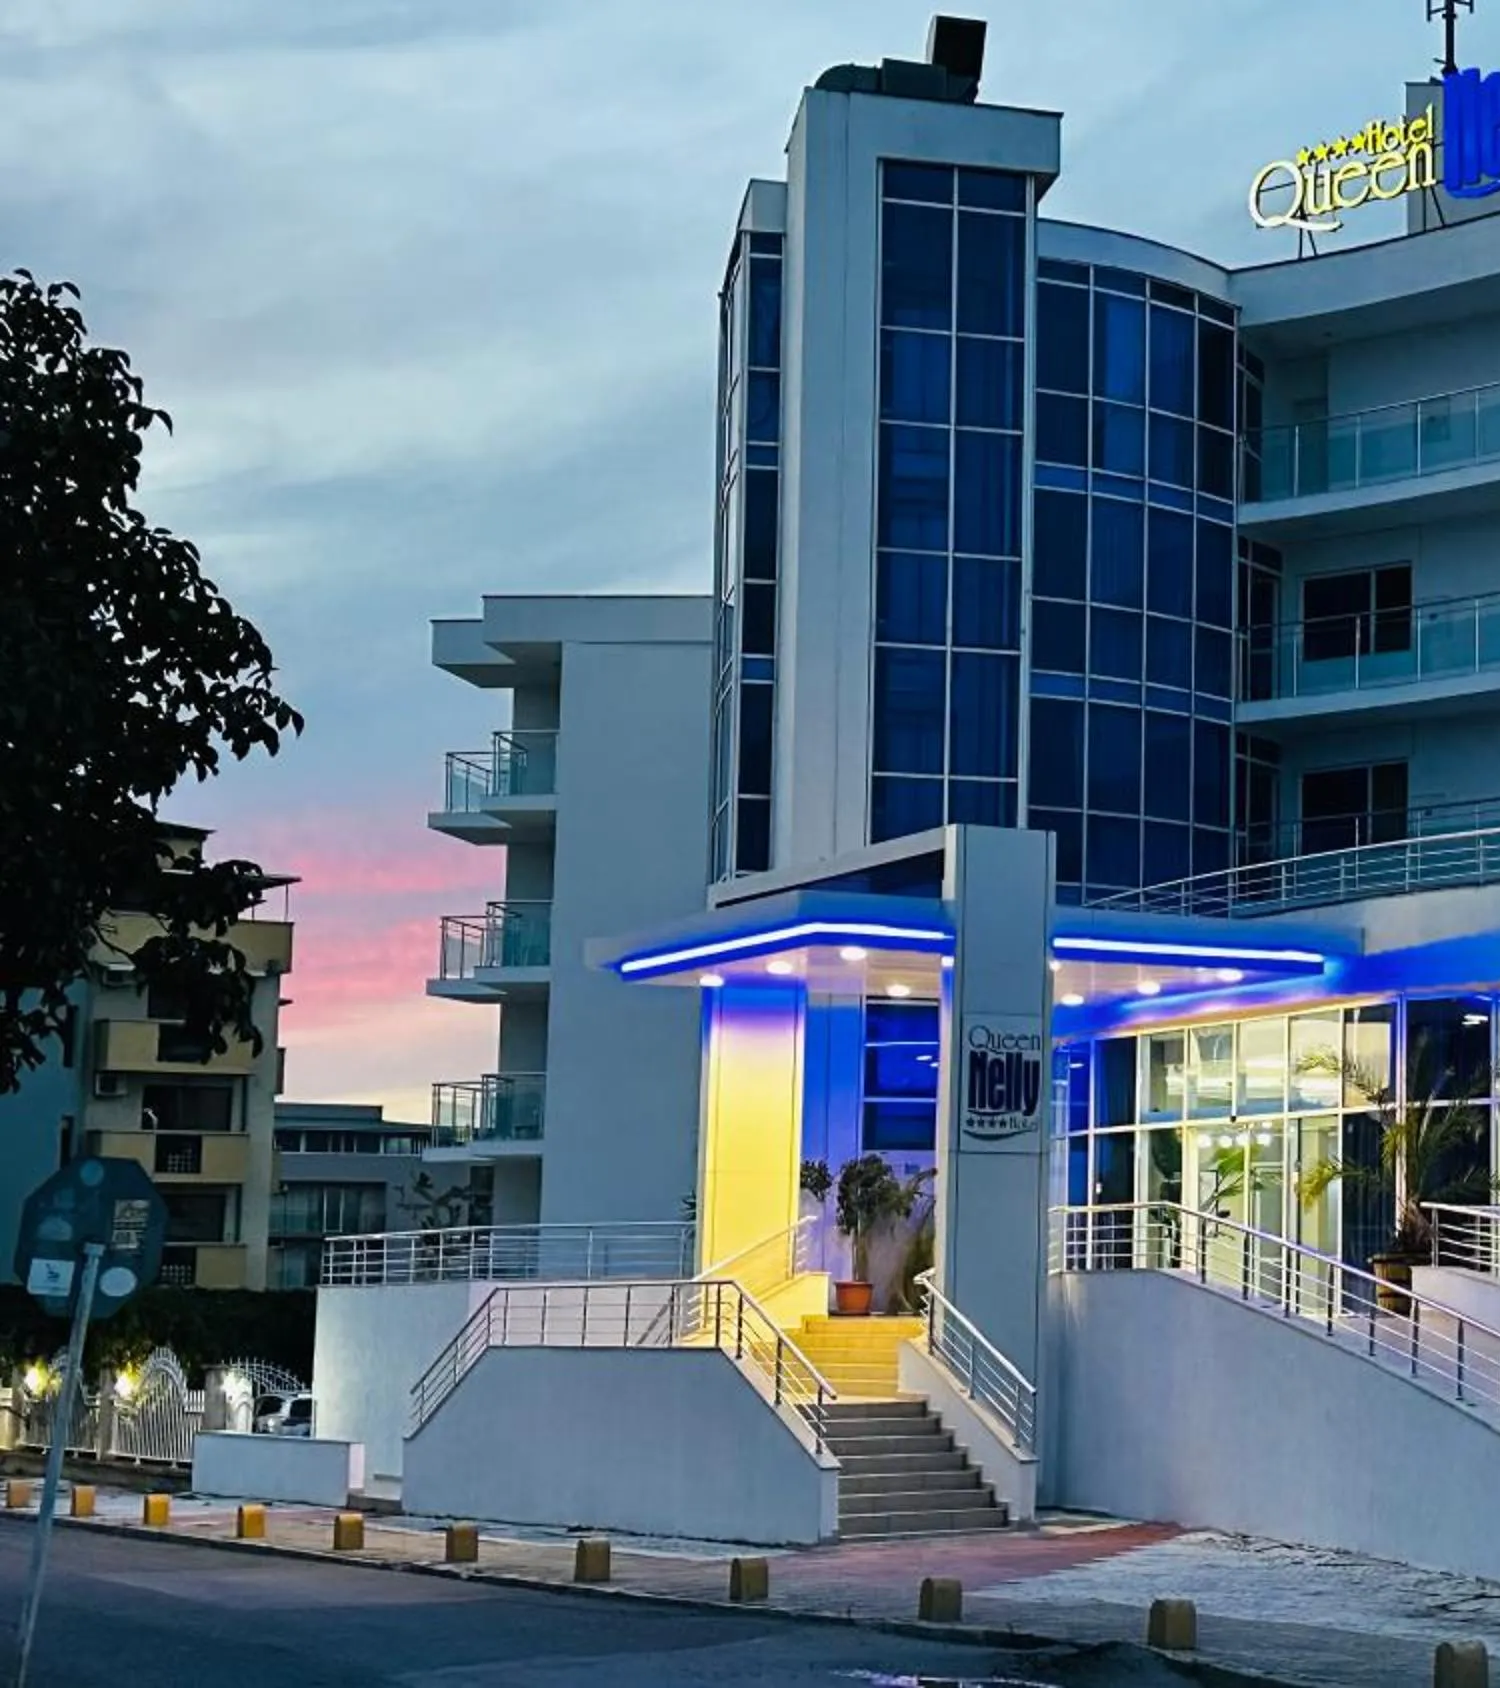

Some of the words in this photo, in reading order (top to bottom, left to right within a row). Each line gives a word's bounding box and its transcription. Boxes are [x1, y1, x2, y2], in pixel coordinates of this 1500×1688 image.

[1365, 102, 1434, 154] Hotel
[1249, 141, 1437, 231] Queen
[969, 1025, 1040, 1054] Queen
[967, 1050, 1040, 1117] Nelly
